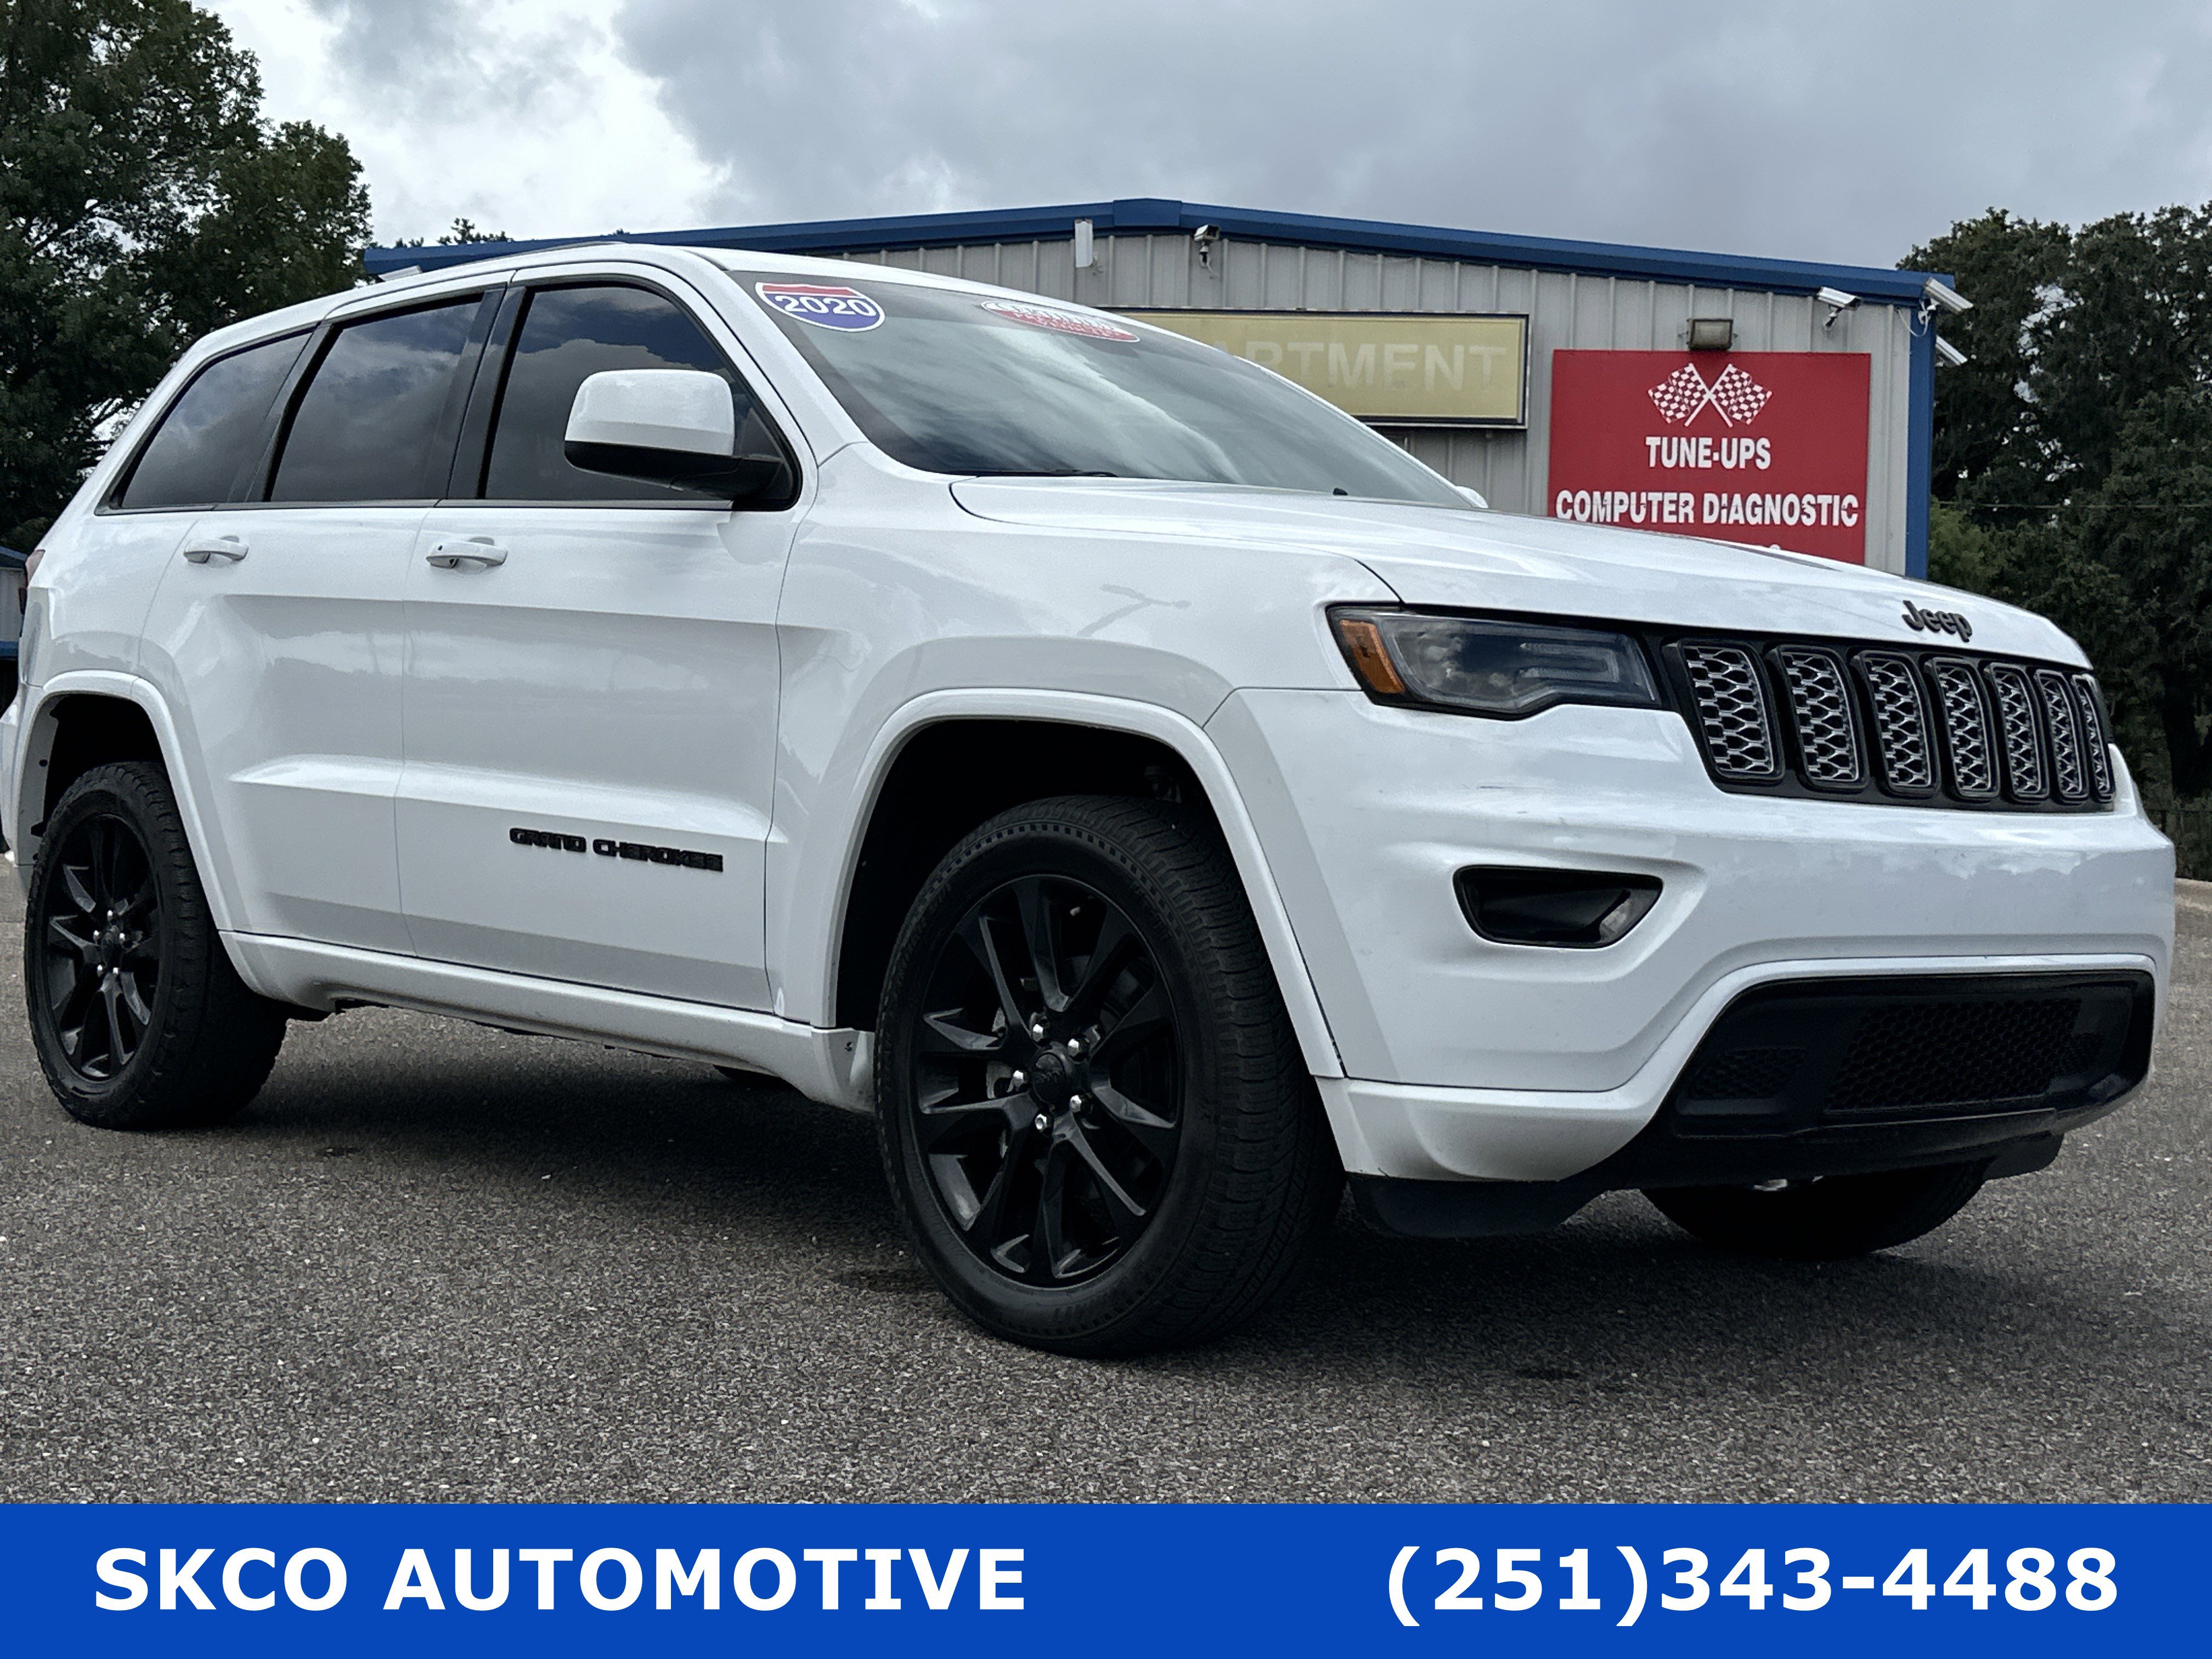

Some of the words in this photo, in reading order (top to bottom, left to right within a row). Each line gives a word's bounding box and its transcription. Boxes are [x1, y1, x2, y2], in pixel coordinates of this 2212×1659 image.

[775, 294, 877, 317] 2020
[1645, 436, 1772, 470] TUNE-UPS
[1556, 489, 1695, 523] COMPUTER
[1702, 493, 1859, 527] DIAGNOSTIC
[1901, 600, 1972, 643] Jeep
[509, 827, 586, 853] GRAND
[592, 838, 724, 872] CHEROKEE
